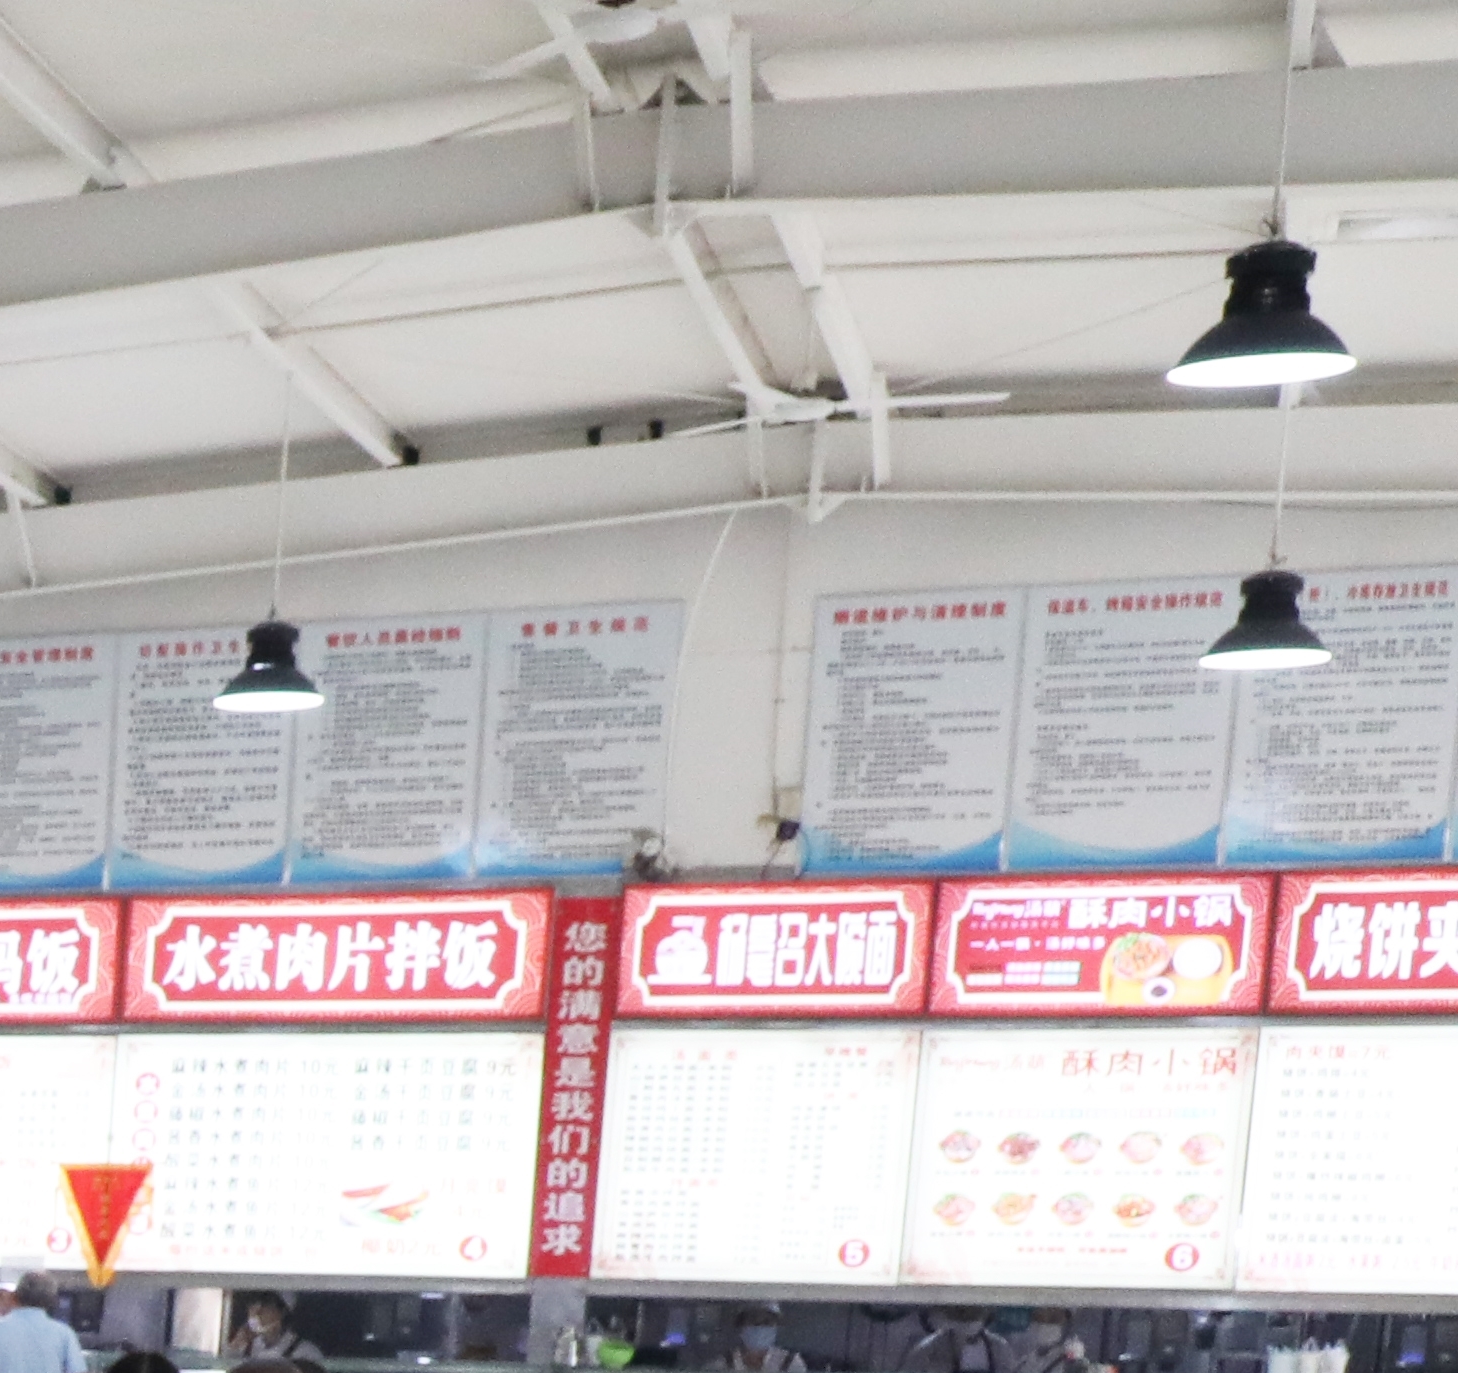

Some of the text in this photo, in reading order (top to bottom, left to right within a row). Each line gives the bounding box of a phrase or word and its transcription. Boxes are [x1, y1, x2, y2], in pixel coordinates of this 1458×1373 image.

[1067, 895, 1233, 930] 酥肉小锅
[163, 921, 498, 992] 水煮肉片拌饭
[1309, 901, 1458, 980] 烧饼夹
[1061, 1047, 1238, 1078] 酥肉小锅
[542, 921, 608, 1256] 您的满意是我们的追求
[844, 1242, 864, 1266] 5
[1174, 1245, 1192, 1269] 6
